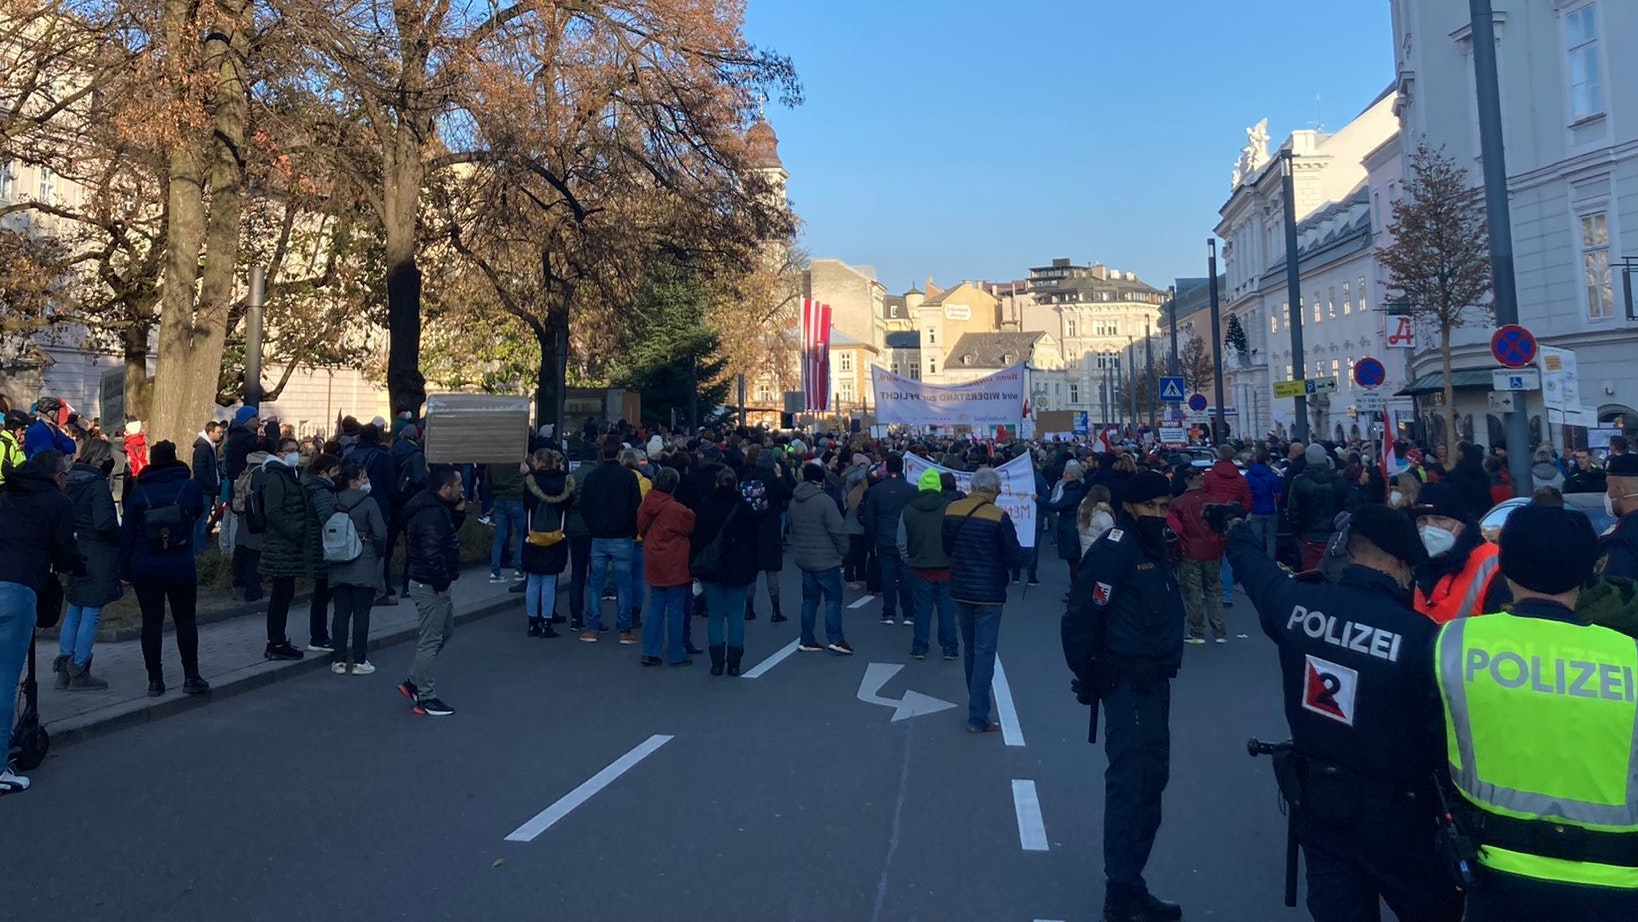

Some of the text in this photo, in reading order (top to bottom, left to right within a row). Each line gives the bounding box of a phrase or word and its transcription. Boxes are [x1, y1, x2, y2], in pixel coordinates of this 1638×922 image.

[1287, 605, 1402, 662] POLIZEI
[1315, 672, 1341, 709] 2
[1466, 648, 1635, 702] POLIZEI
